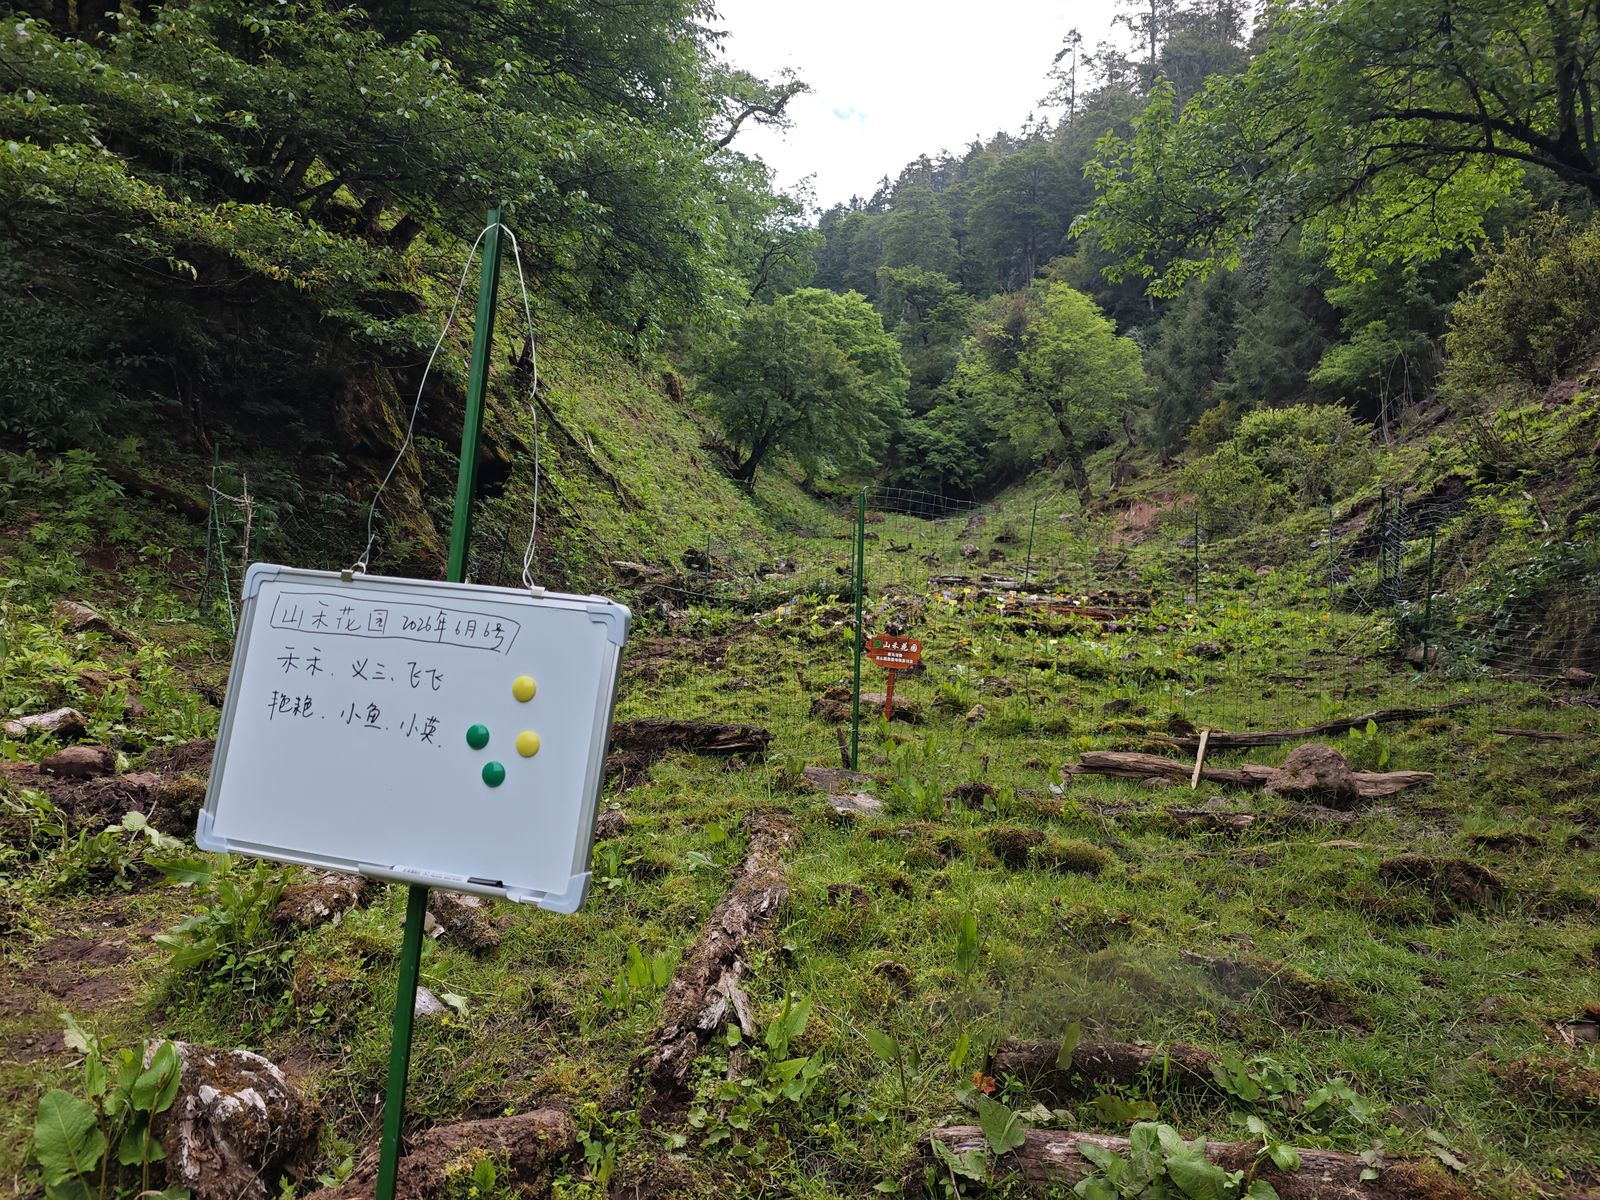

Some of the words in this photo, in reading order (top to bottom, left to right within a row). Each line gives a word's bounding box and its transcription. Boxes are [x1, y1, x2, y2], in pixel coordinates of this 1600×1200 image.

[281, 601, 389, 634] 山禾花园
[882, 641, 918, 653] 山禾花园
